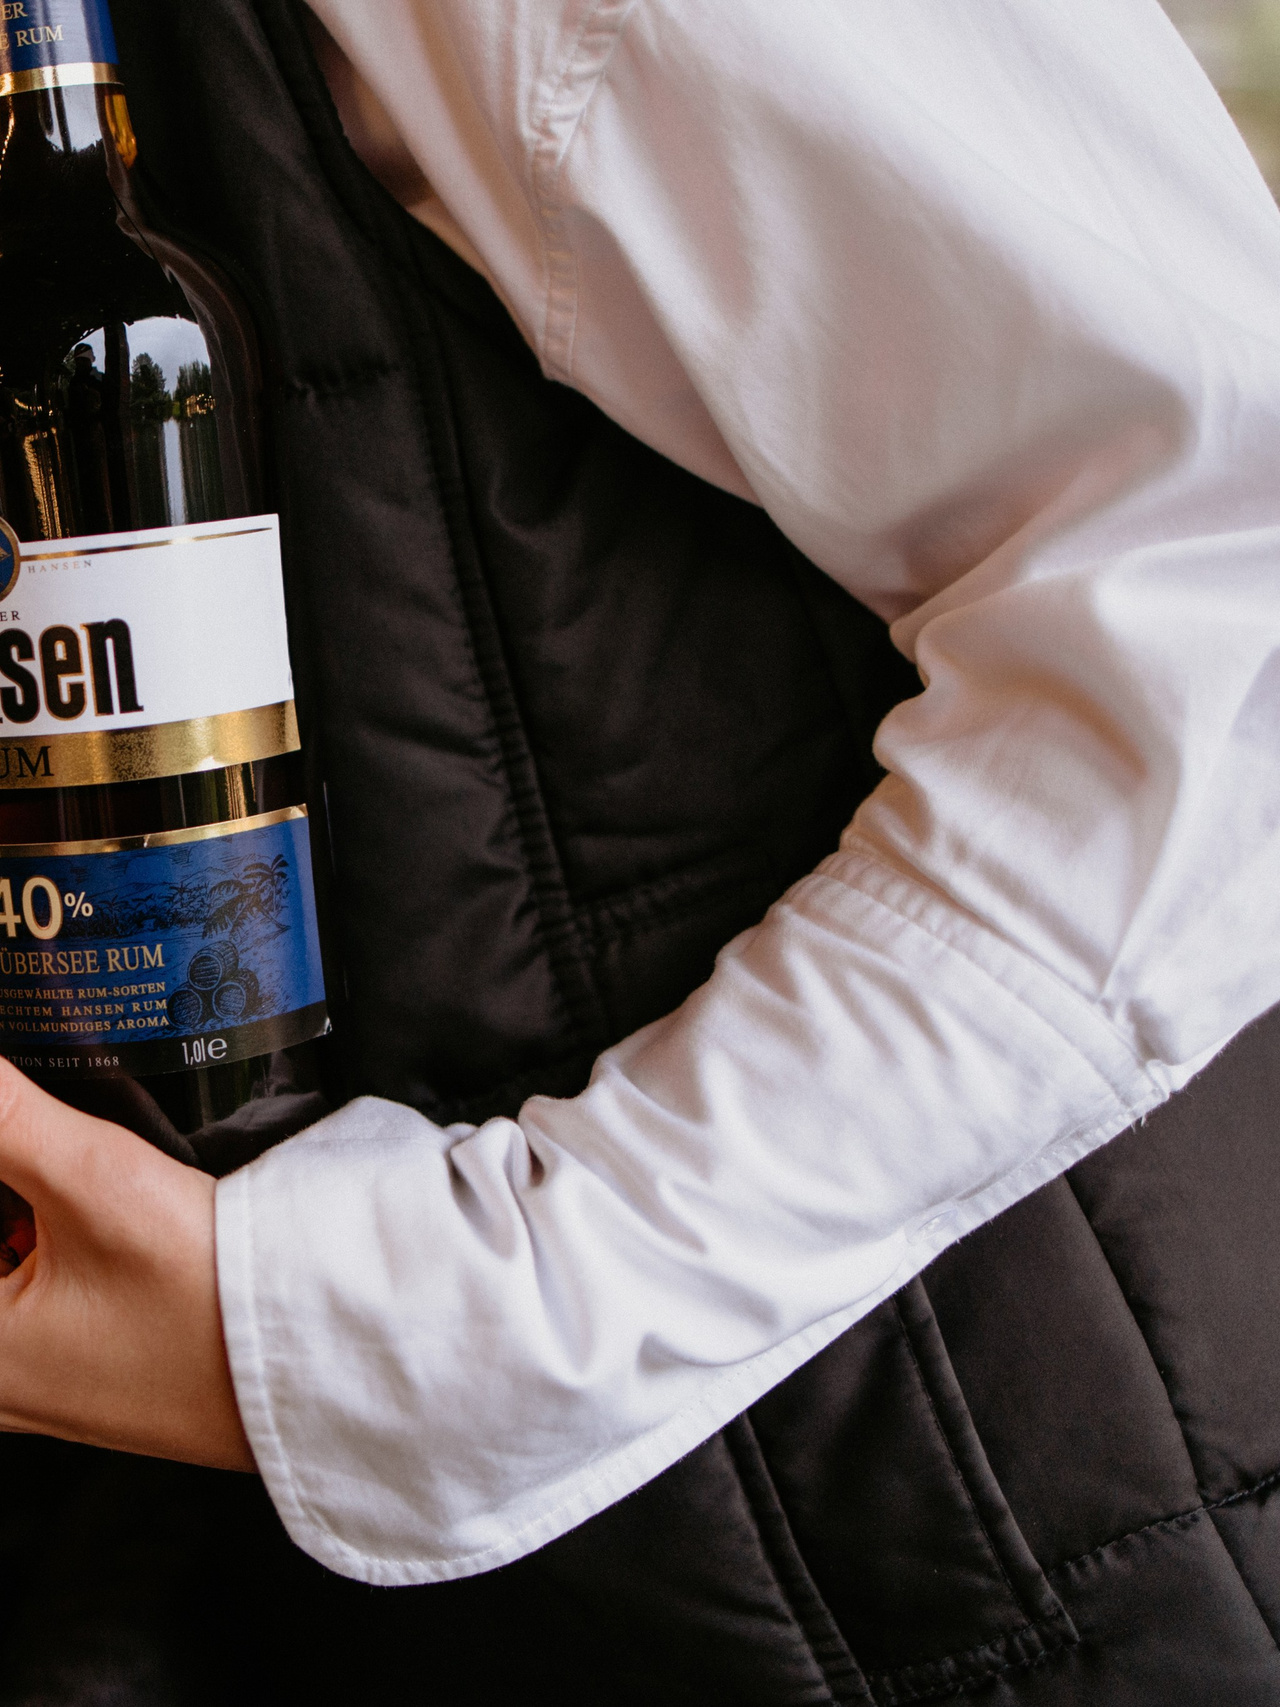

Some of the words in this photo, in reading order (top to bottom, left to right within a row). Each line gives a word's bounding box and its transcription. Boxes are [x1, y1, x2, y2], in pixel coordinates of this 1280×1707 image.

[15, 25, 64, 47] RUM
[27, 559, 92, 573] HANSEN
[0, 947, 100, 975] ÜBERSEE
[105, 944, 165, 972] RUM
[78, 981, 166, 998] RUM-SORTEN
[0, 1005, 52, 1017] ECHTEM
[62, 1003, 124, 1016] HANSEN
[132, 999, 167, 1012] RUM
[8, 1020, 111, 1032] VOLLMUNDIGES
[116, 1015, 170, 1030] AROMA
[48, 1057, 80, 1067] SEIT
[88, 1055, 120, 1067] 1868
